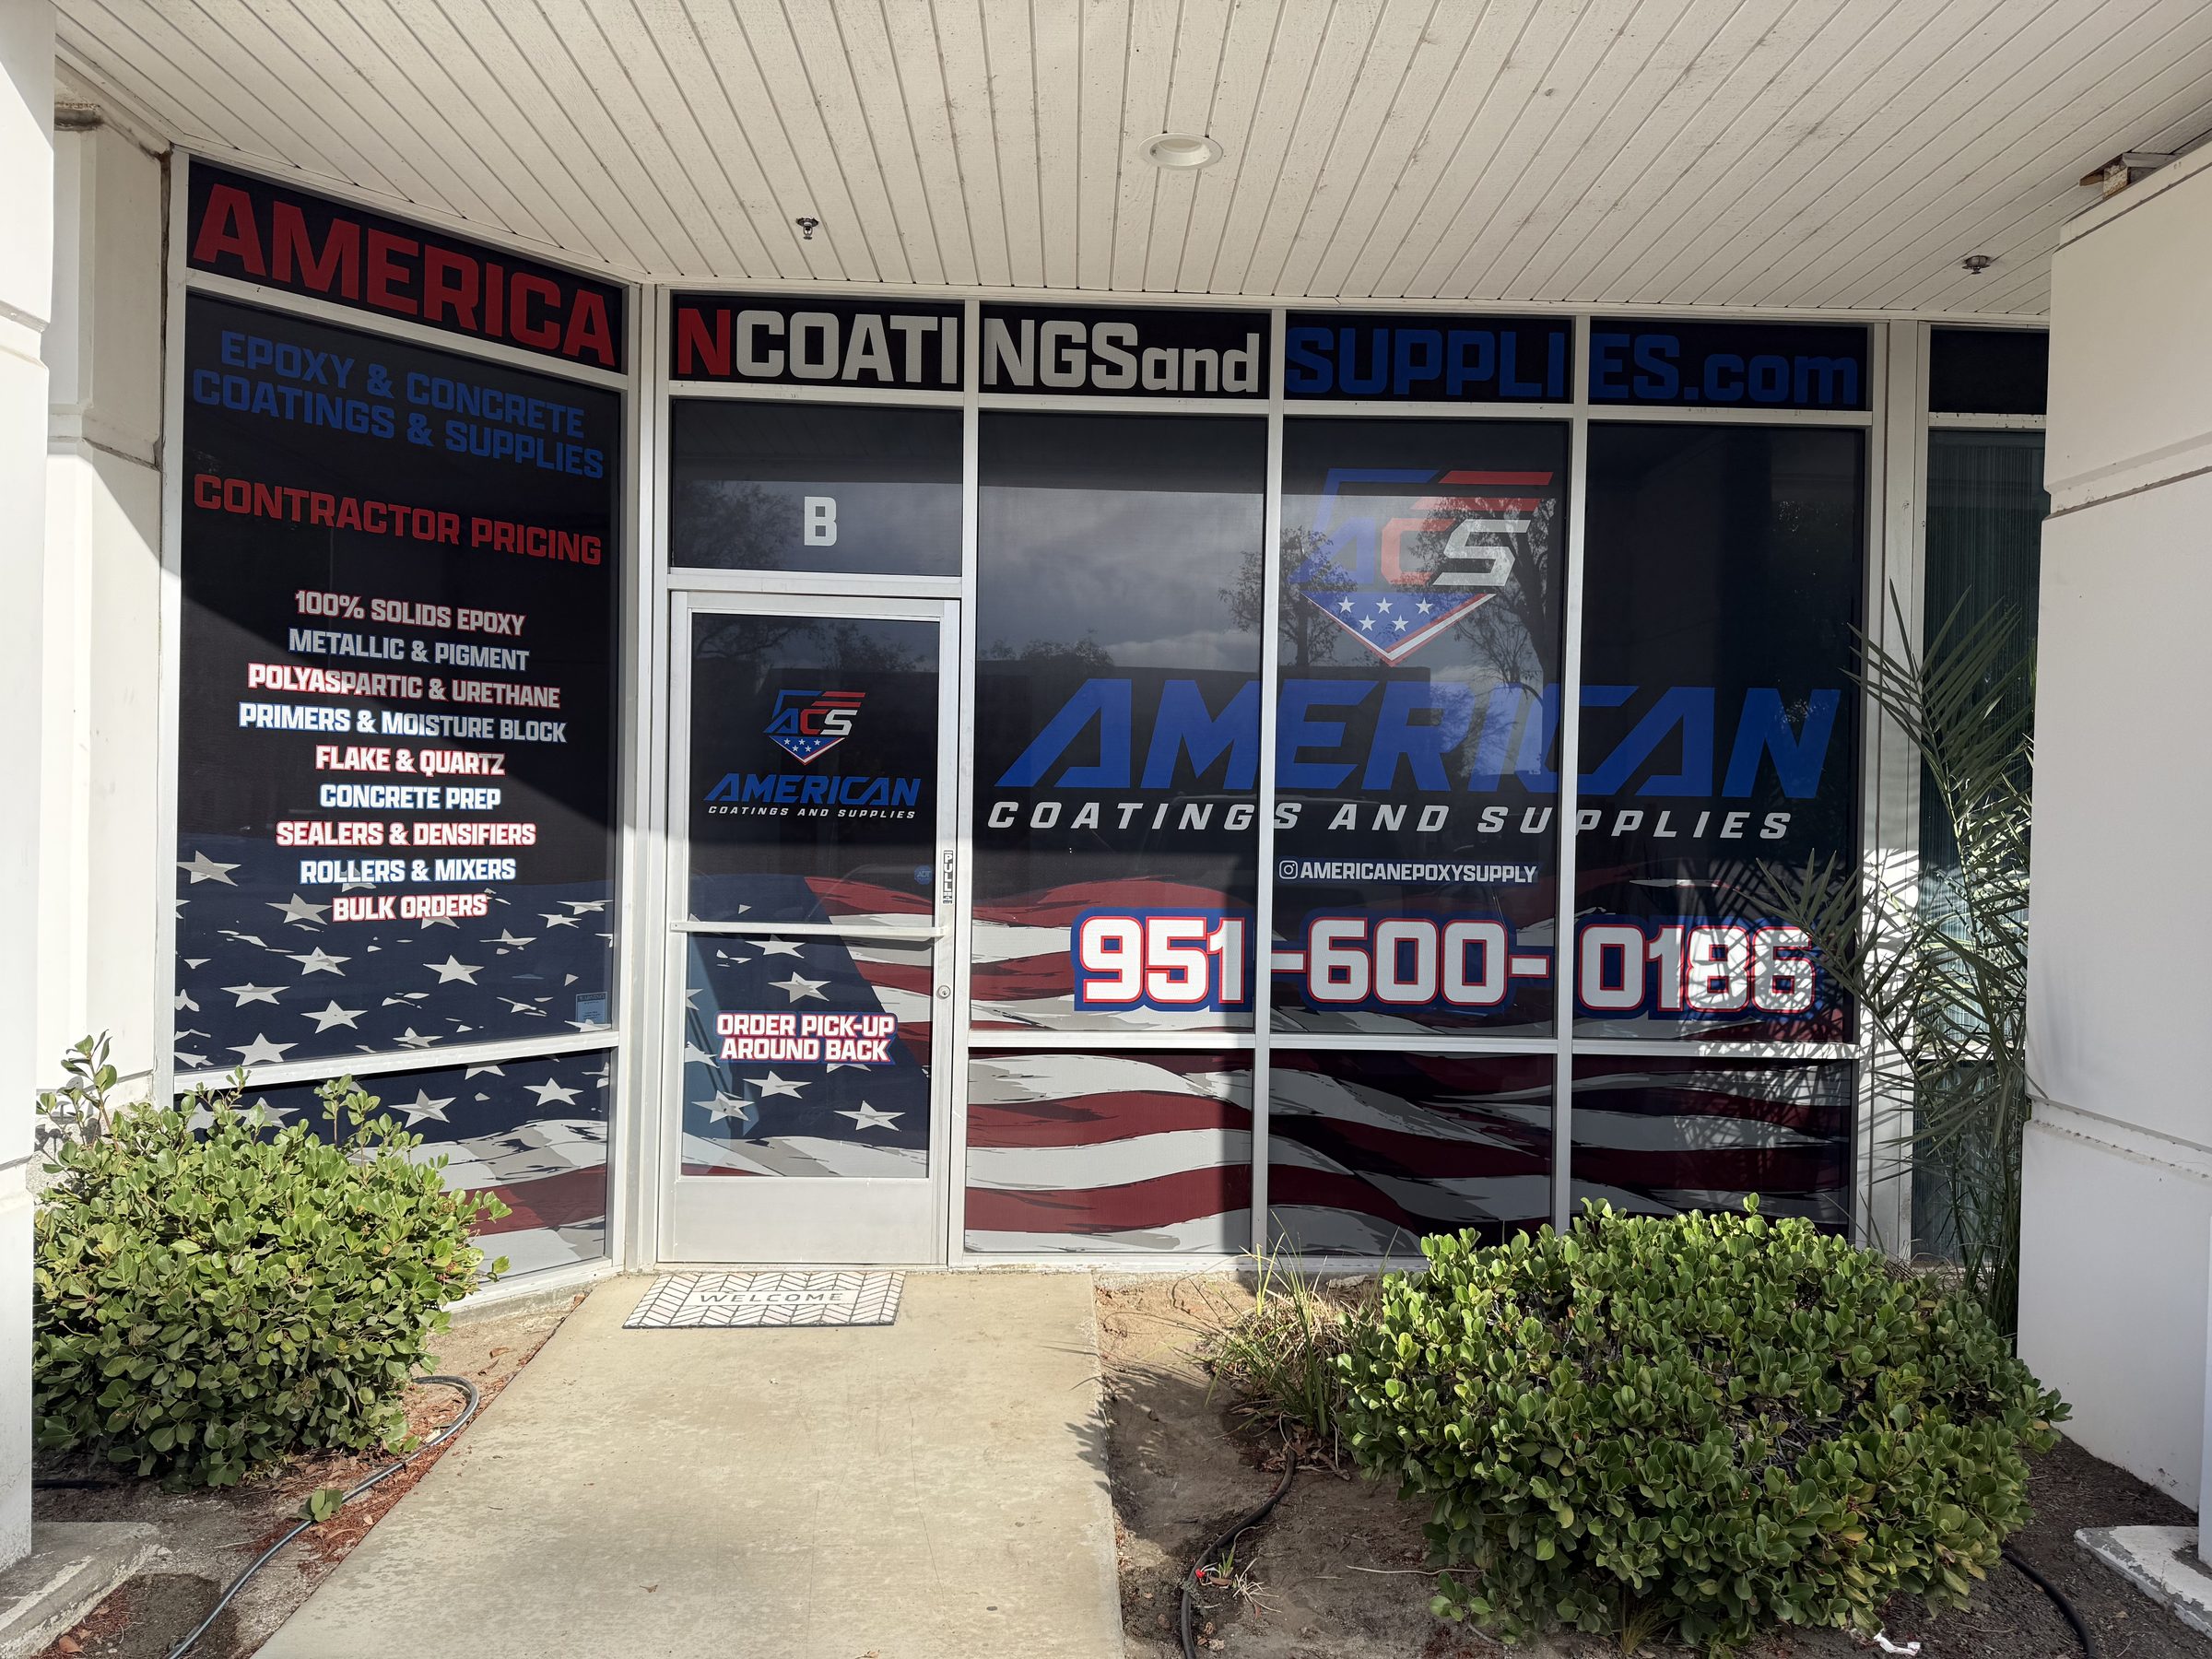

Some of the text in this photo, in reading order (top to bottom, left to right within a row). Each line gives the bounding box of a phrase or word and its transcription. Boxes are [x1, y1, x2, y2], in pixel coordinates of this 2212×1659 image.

[221, 330, 585, 440] EPOXY & CONCRETE
[193, 369, 604, 479] COATINGS & SUPPLIES
[194, 473, 602, 566] CONTRACTOR PRICING
[804, 496, 838, 547] B
[295, 590, 525, 636] 100% SOLIDS EPOXY
[288, 628, 530, 671] METALLIC & PIGMENT
[247, 663, 560, 709] POLYASPARTIC & URETHANE
[239, 701, 567, 743] PRIMERS & MOISTURE BLOCK
[763, 708, 858, 735] ACS
[994, 678, 1841, 798] AMERICAN
[315, 745, 506, 777] FLAKE & QUARTZ
[320, 784, 501, 810] CONCRETE PREP
[703, 772, 921, 806] AMERICAN
[708, 805, 915, 819] COATINGS AND SUPPLIES
[987, 801, 1791, 840] COATINGS AND SUPPLIES
[276, 821, 536, 847] SEALERS & DENSIFIERS
[300, 858, 516, 885] ROLLERS & MIXERS
[944, 853, 953, 892] PULL
[1300, 862, 1537, 884] AMERICANEPOXYSUPPLY
[333, 893, 488, 922] BULK ORDERS
[716, 1014, 895, 1038] ORDER PICK-UP
[721, 1038, 890, 1062] AROUND BACK
[700, 1292, 843, 1303] WELCOME
